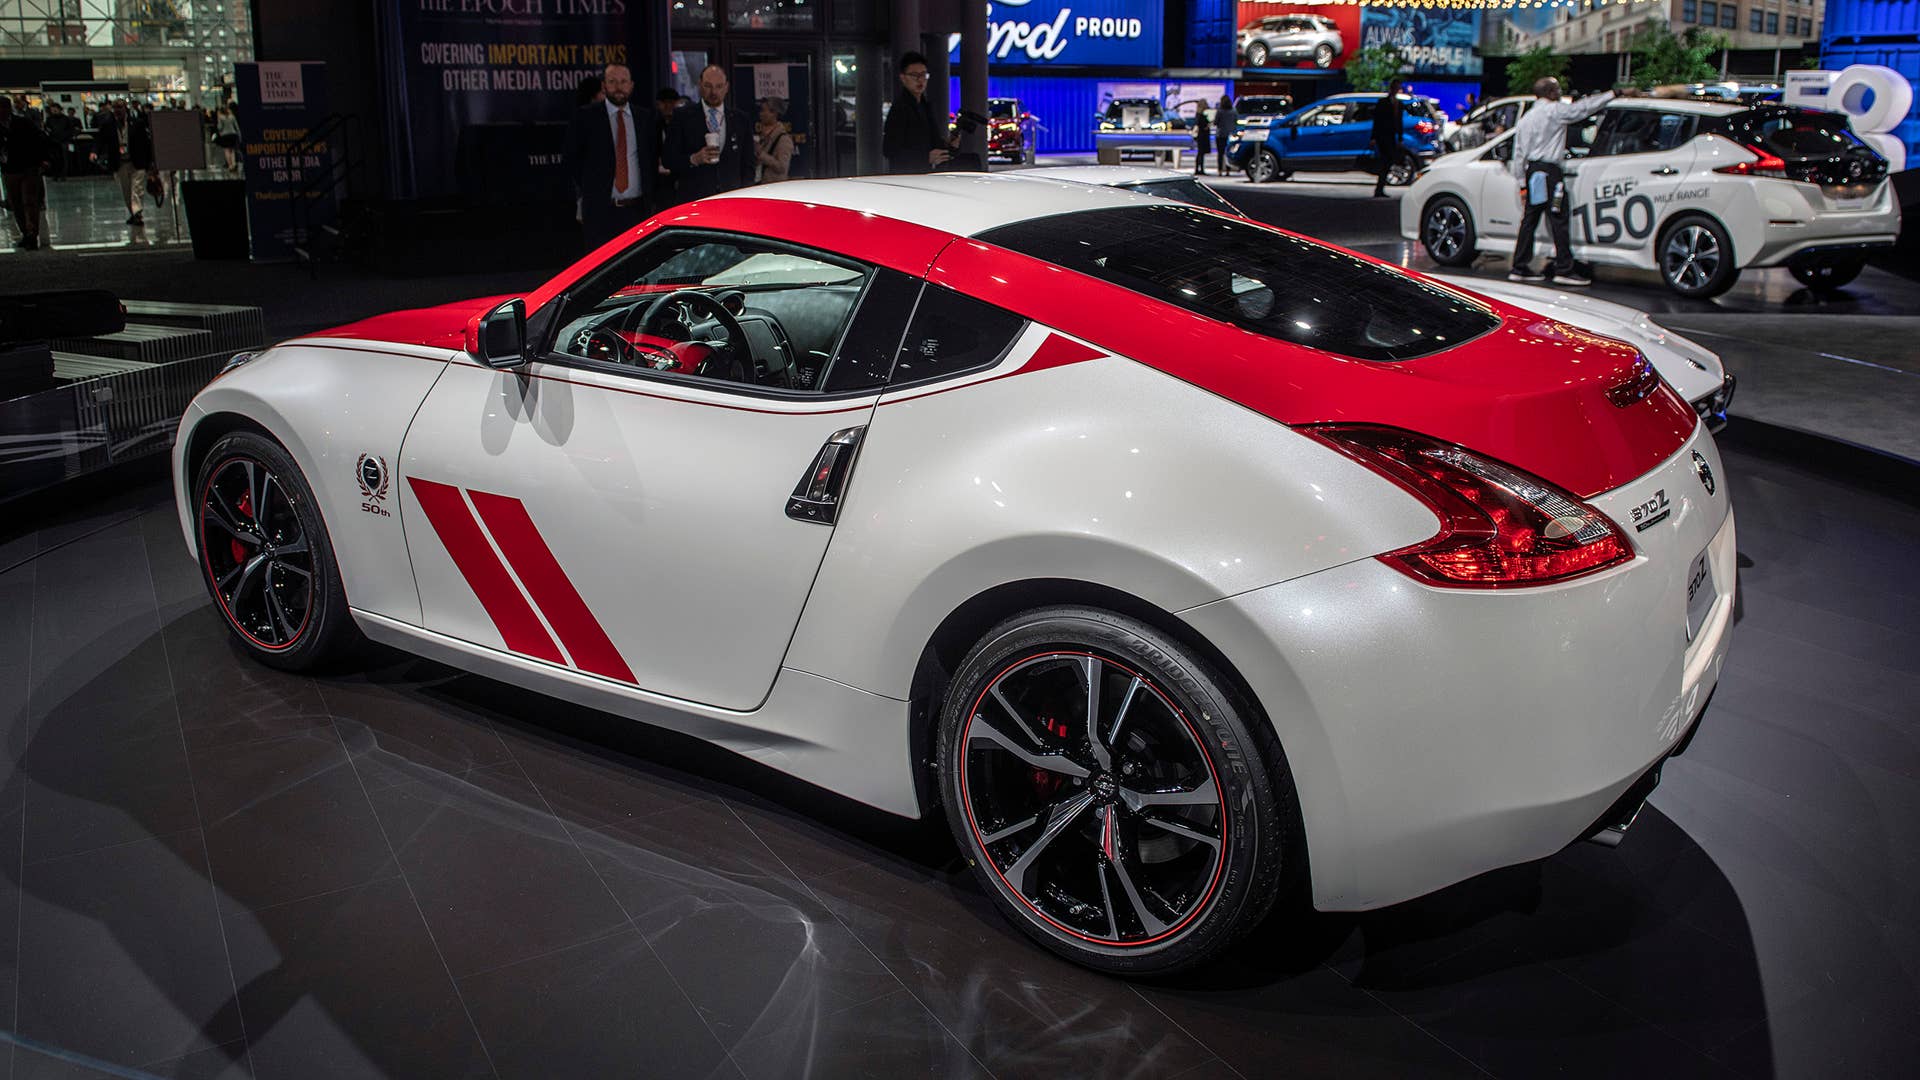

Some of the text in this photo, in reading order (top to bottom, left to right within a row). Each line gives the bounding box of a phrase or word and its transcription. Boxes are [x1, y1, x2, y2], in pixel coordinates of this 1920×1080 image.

[460, 0, 543, 15] EPOCH
[554, 0, 626, 15] TIMES
[1076, 17, 1142, 38] PROUD
[1365, 26, 1416, 47] ALWAYS
[421, 42, 627, 65] COVERING IMPORTANT NEWS
[442, 69, 489, 91] OTHER
[493, 69, 543, 91] MEDIA
[1594, 181, 1634, 200] LEAF
[1654, 187, 1711, 203] MILE RANGE
[1573, 194, 1656, 244] 150
[361, 502, 391, 517] 50th
[1630, 489, 1670, 523] 370Z
[1689, 556, 1706, 602] 370Z
